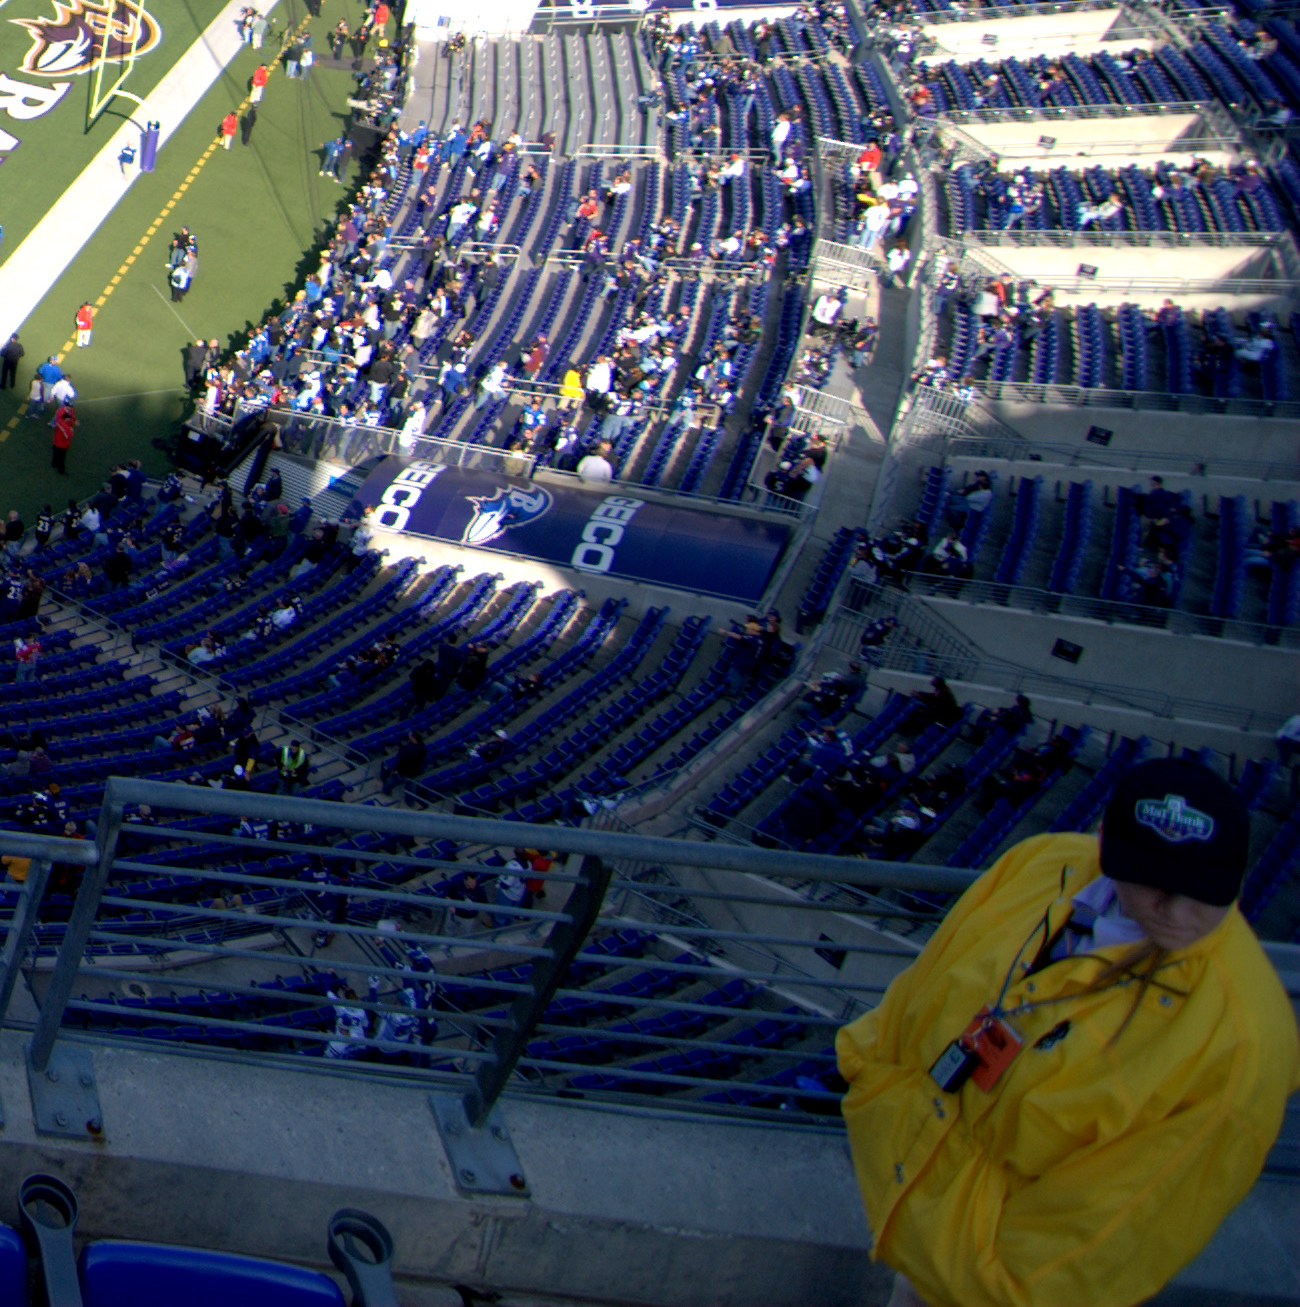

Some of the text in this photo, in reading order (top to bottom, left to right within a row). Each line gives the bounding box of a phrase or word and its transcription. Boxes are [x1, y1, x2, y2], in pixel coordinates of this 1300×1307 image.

[38, 519, 50, 532] 23
[373, 459, 449, 534] GEICO
[570, 495, 646, 573] GEICO
